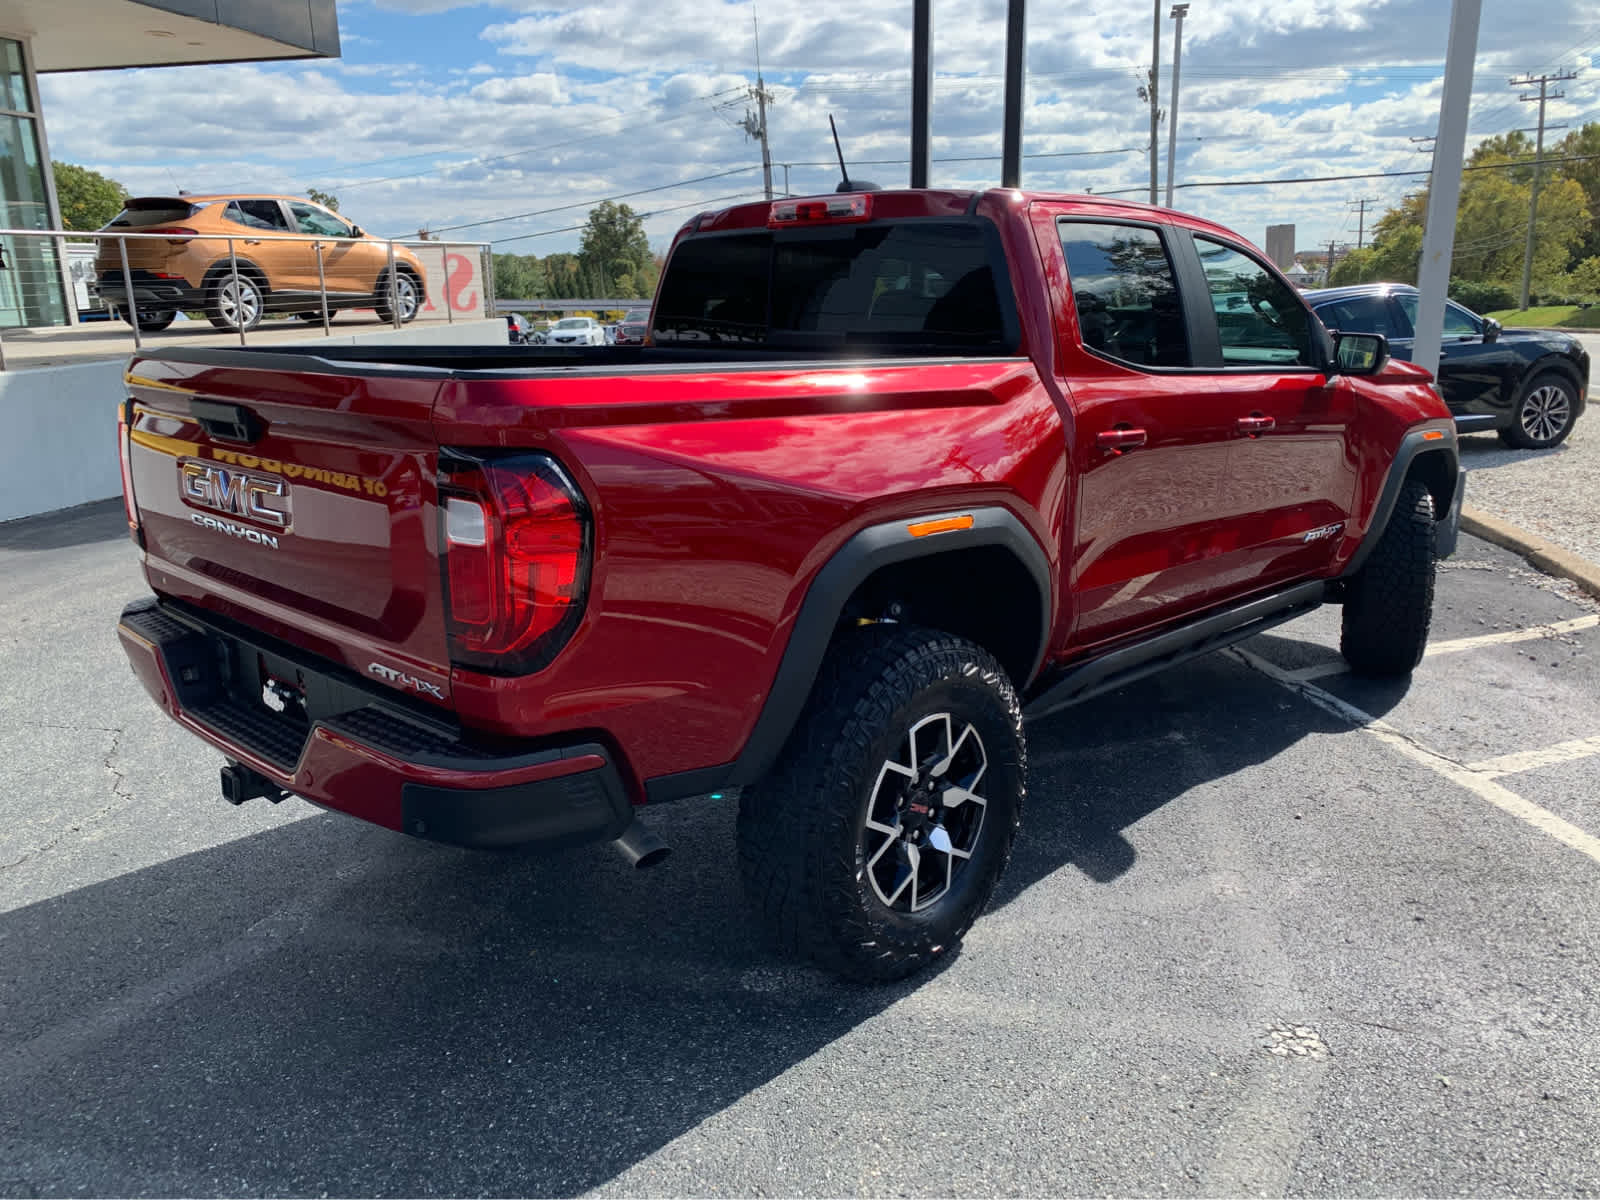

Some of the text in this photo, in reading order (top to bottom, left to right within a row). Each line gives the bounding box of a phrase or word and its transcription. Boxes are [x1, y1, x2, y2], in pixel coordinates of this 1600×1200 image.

[182, 463, 292, 526] GMC
[191, 513, 279, 549] CANYON
[368, 662, 445, 700] AT4X
